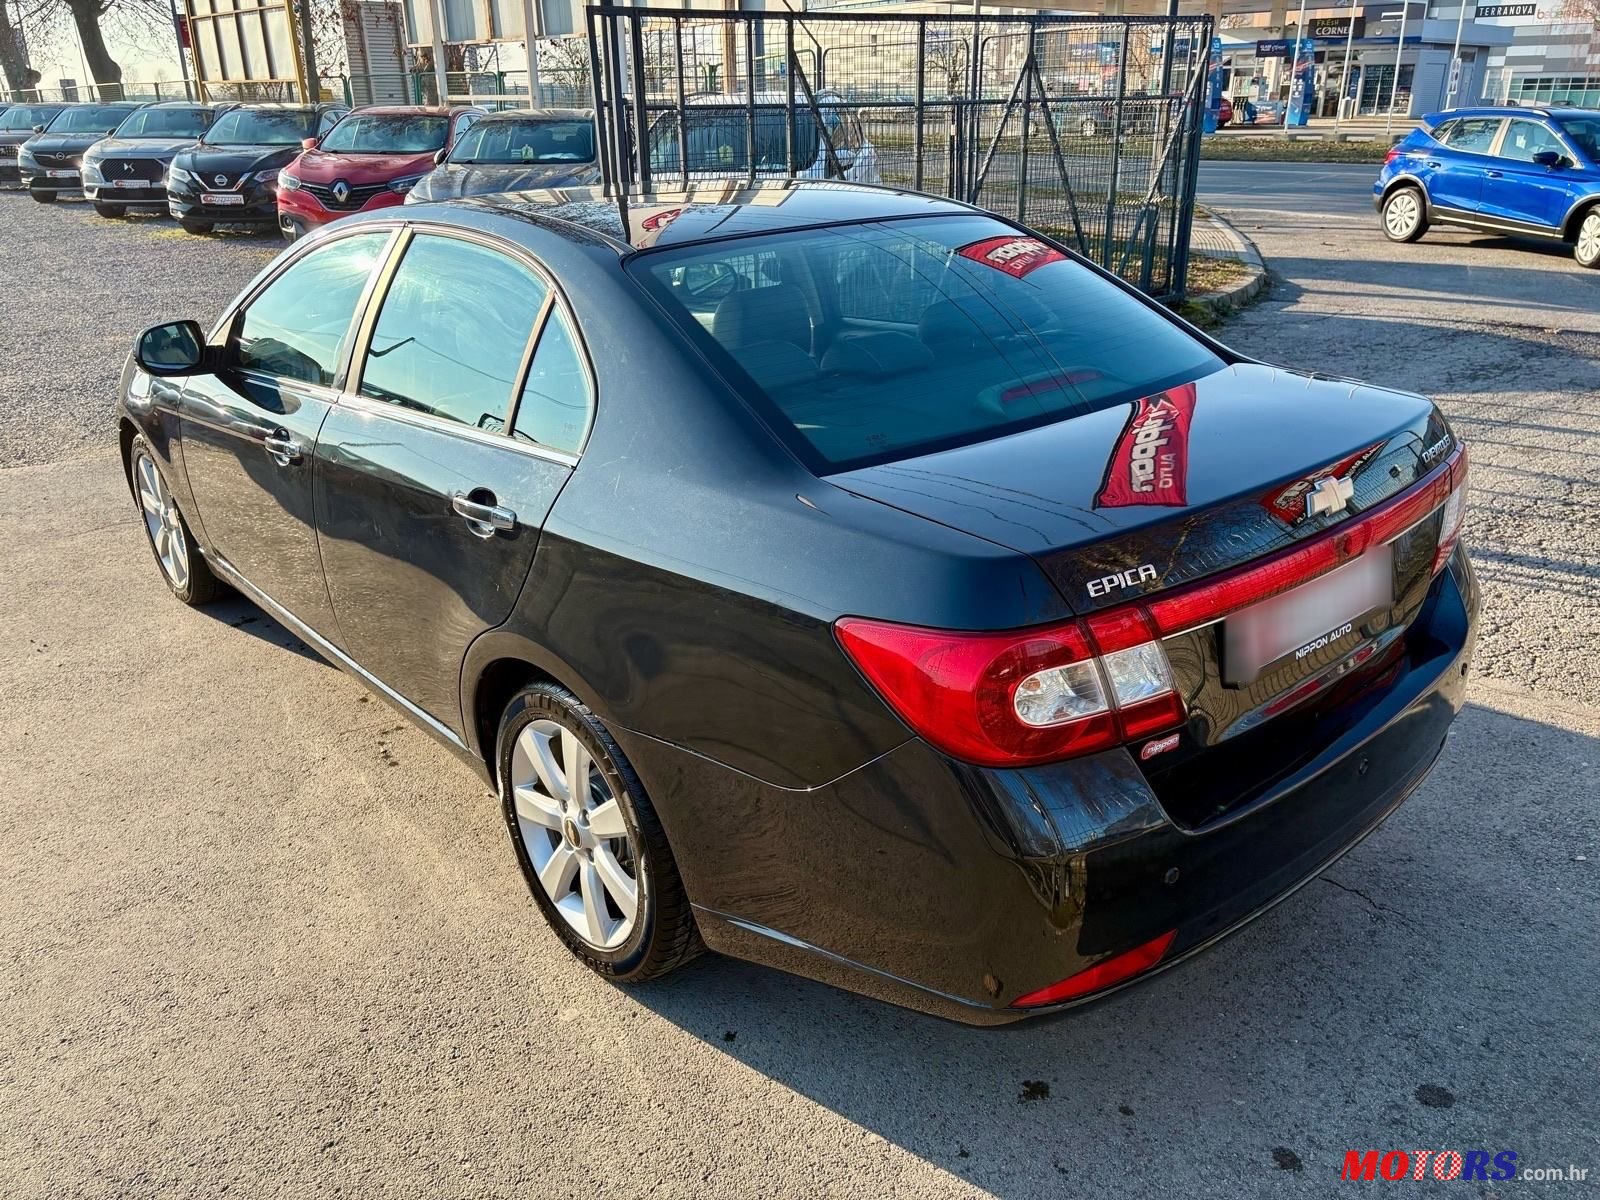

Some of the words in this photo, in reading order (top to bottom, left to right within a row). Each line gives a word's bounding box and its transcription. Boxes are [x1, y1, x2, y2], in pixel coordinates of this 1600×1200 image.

[1479, 5, 1533, 16] TERRANOVA
[1315, 26, 1353, 35] CORNE
[1086, 564, 1157, 598] EPICA
[1295, 635, 1328, 660] NIPPON
[1330, 623, 1352, 641] AUTO
